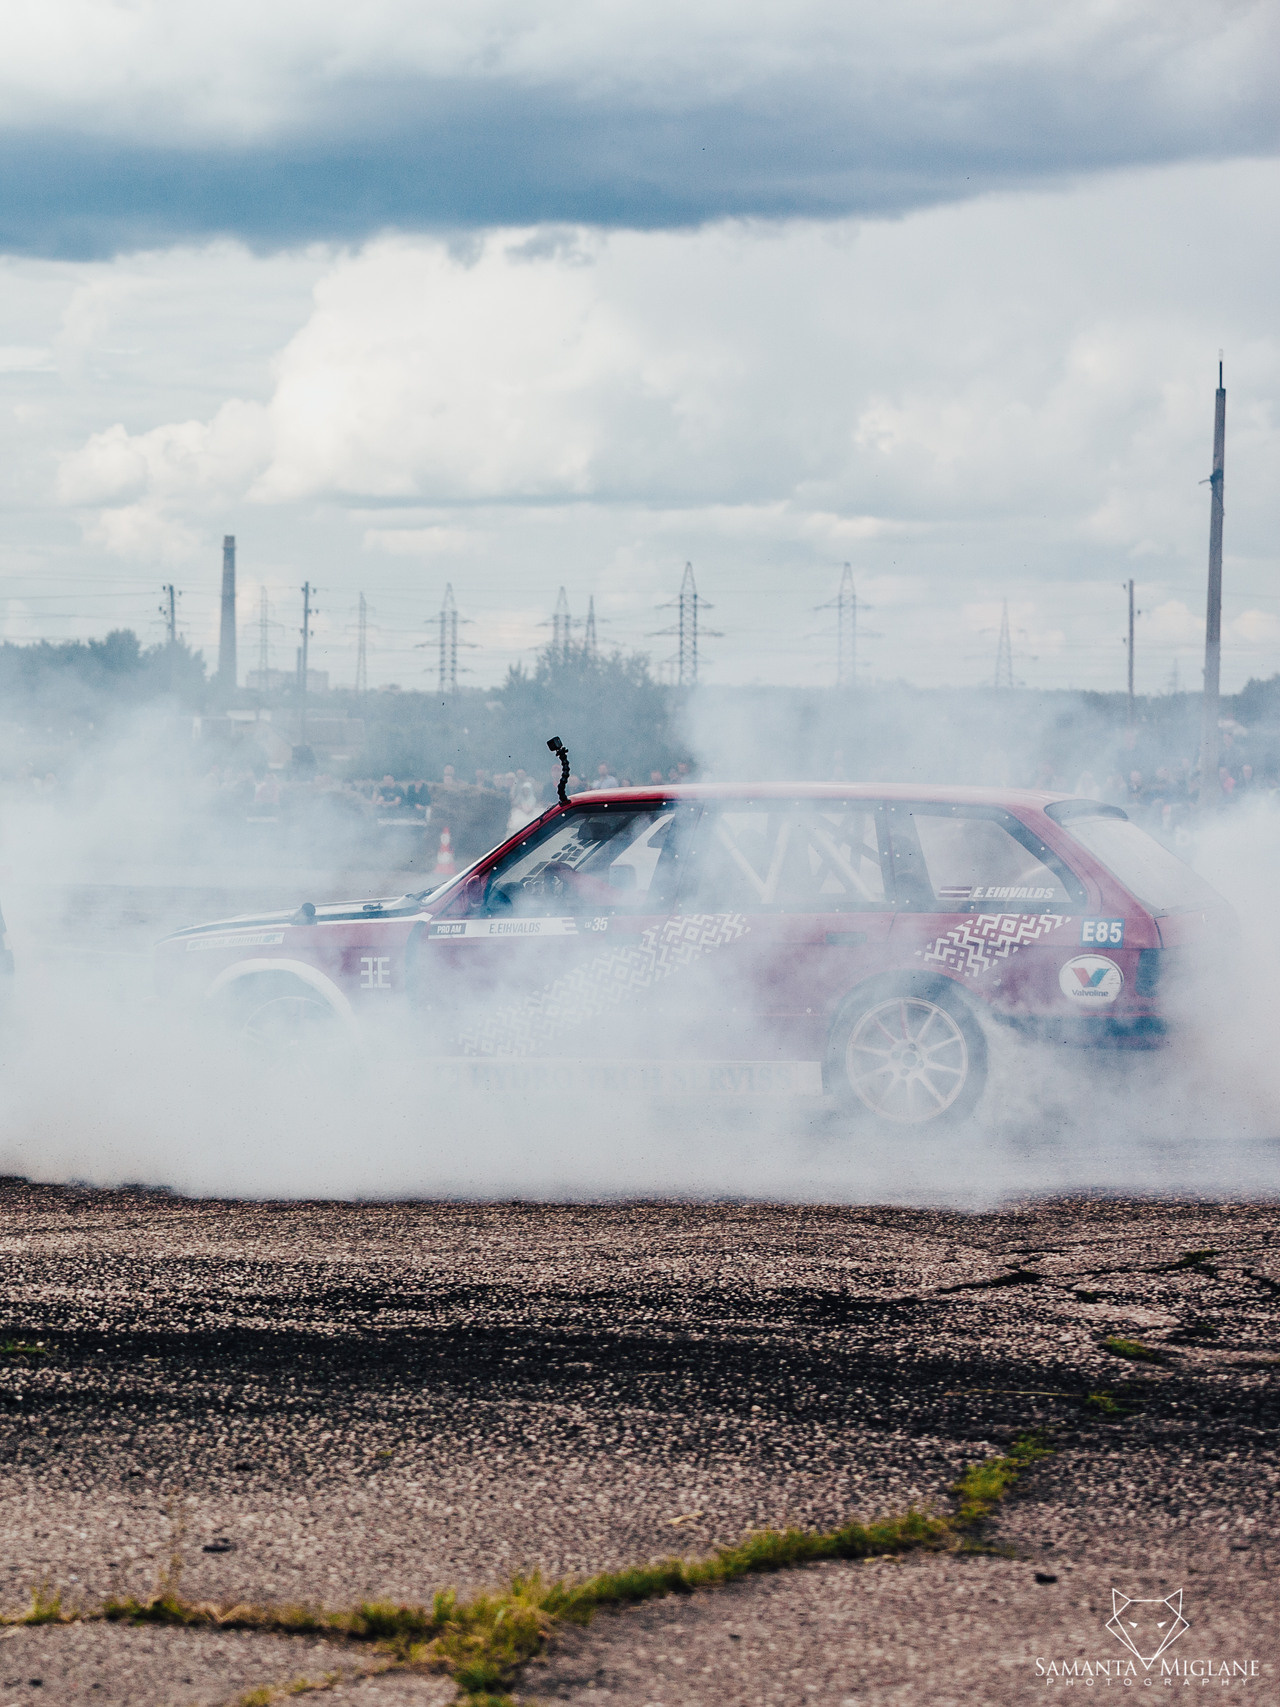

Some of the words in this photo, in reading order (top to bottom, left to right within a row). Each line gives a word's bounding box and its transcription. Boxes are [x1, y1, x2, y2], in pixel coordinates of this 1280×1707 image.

[592, 917, 608, 931] 35
[1082, 921, 1122, 943] E85
[1072, 989, 1109, 998] Valvoline
